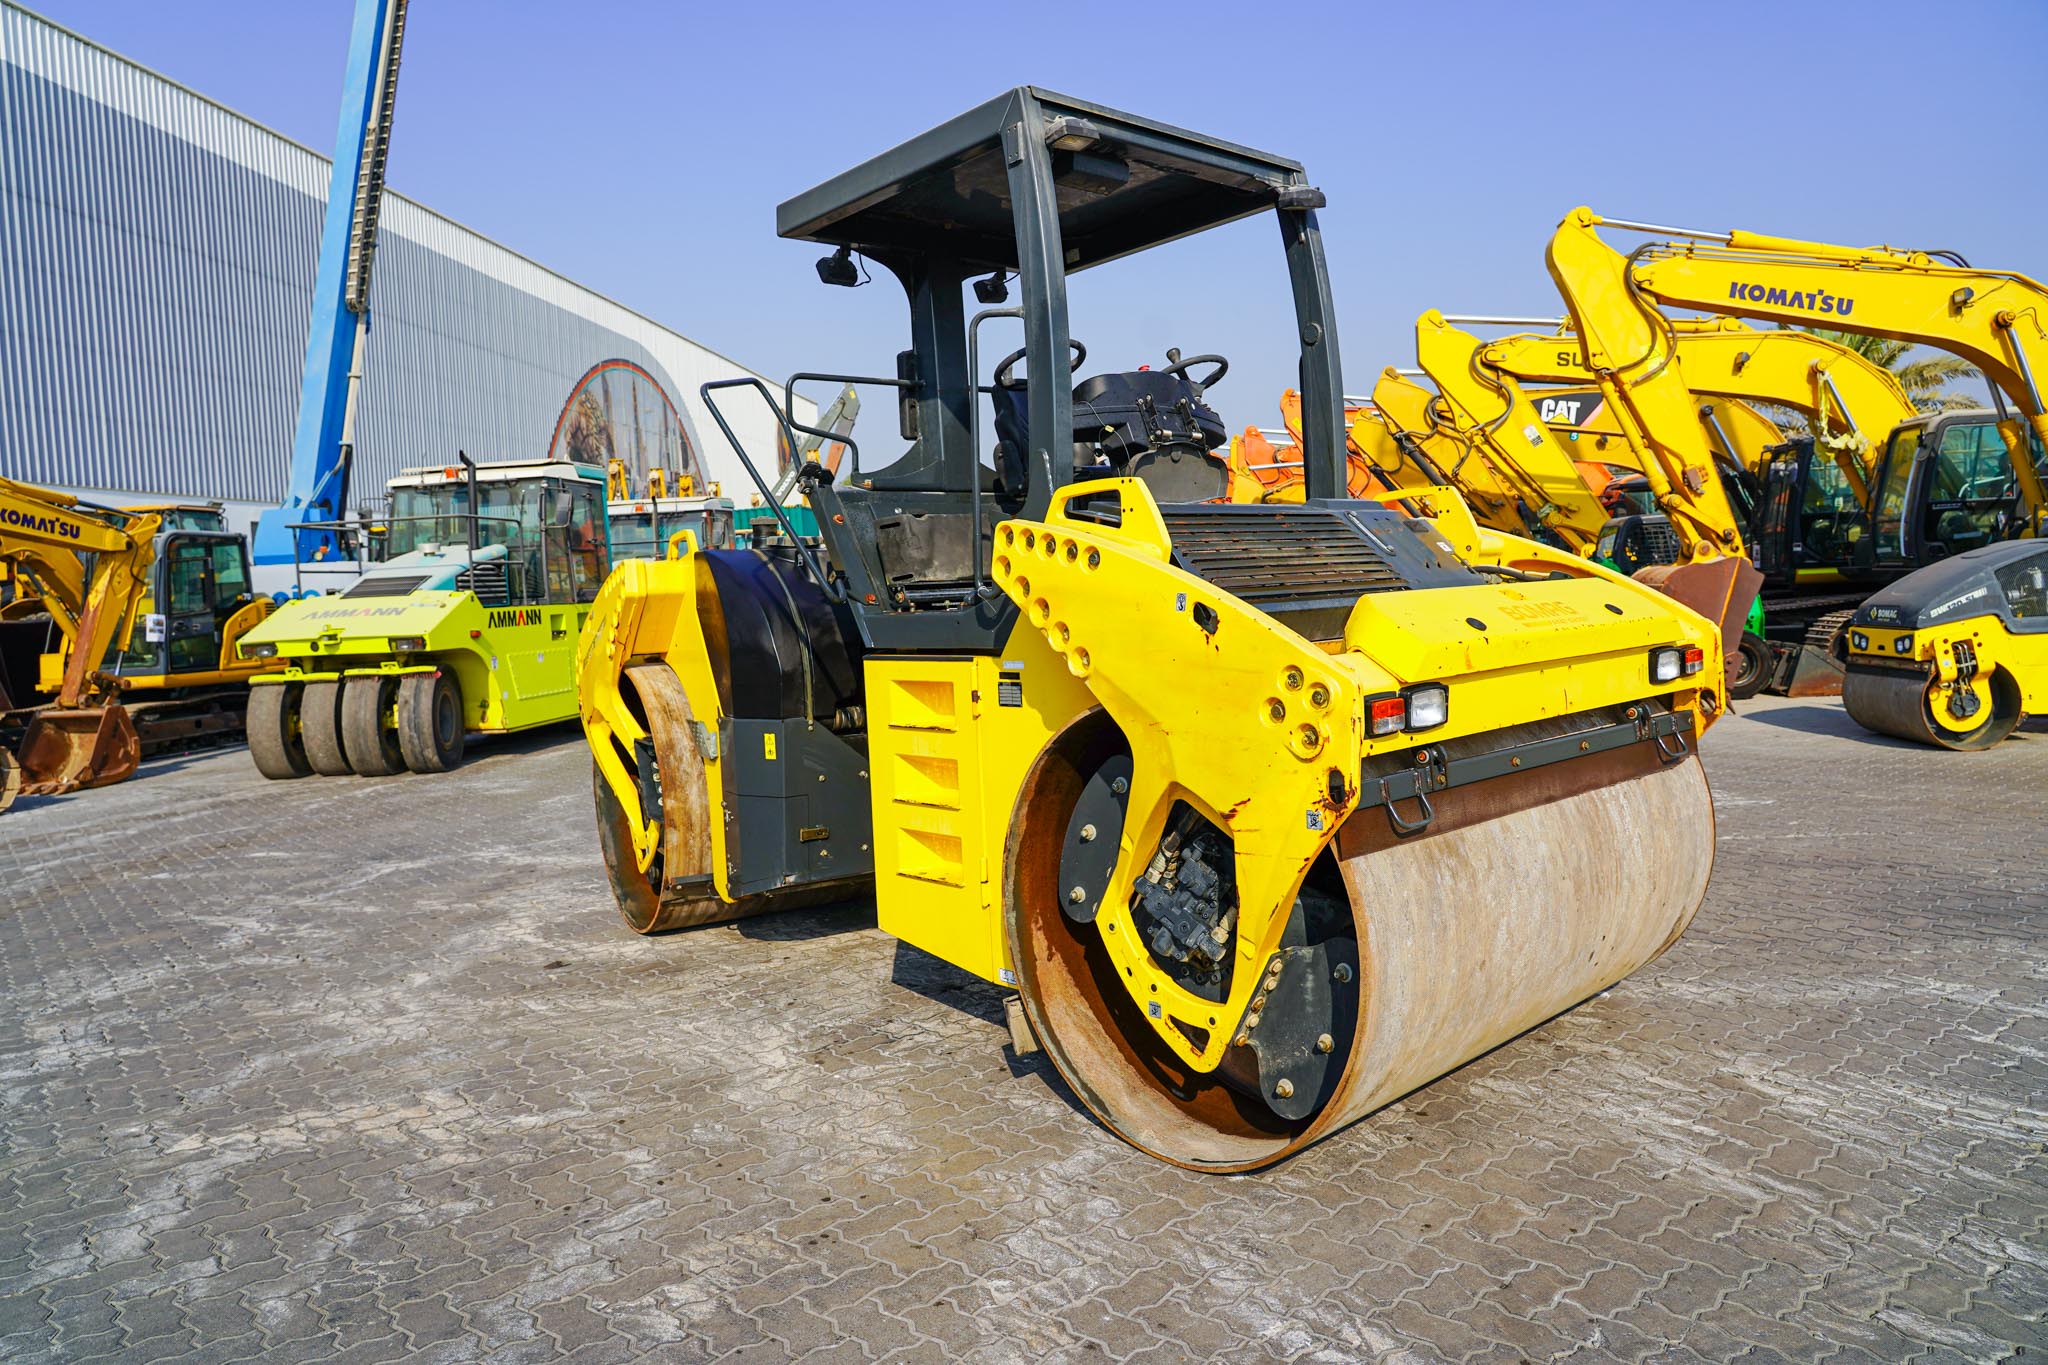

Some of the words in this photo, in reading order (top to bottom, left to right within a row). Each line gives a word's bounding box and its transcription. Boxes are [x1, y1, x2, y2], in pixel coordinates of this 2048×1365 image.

[1729, 282, 1853, 315] KOMATSU
[1540, 399, 1580, 425] CAT
[775, 471, 796, 496] VOLVO
[301, 607, 408, 621] AMMANN
[488, 609, 542, 628] AMMANN
